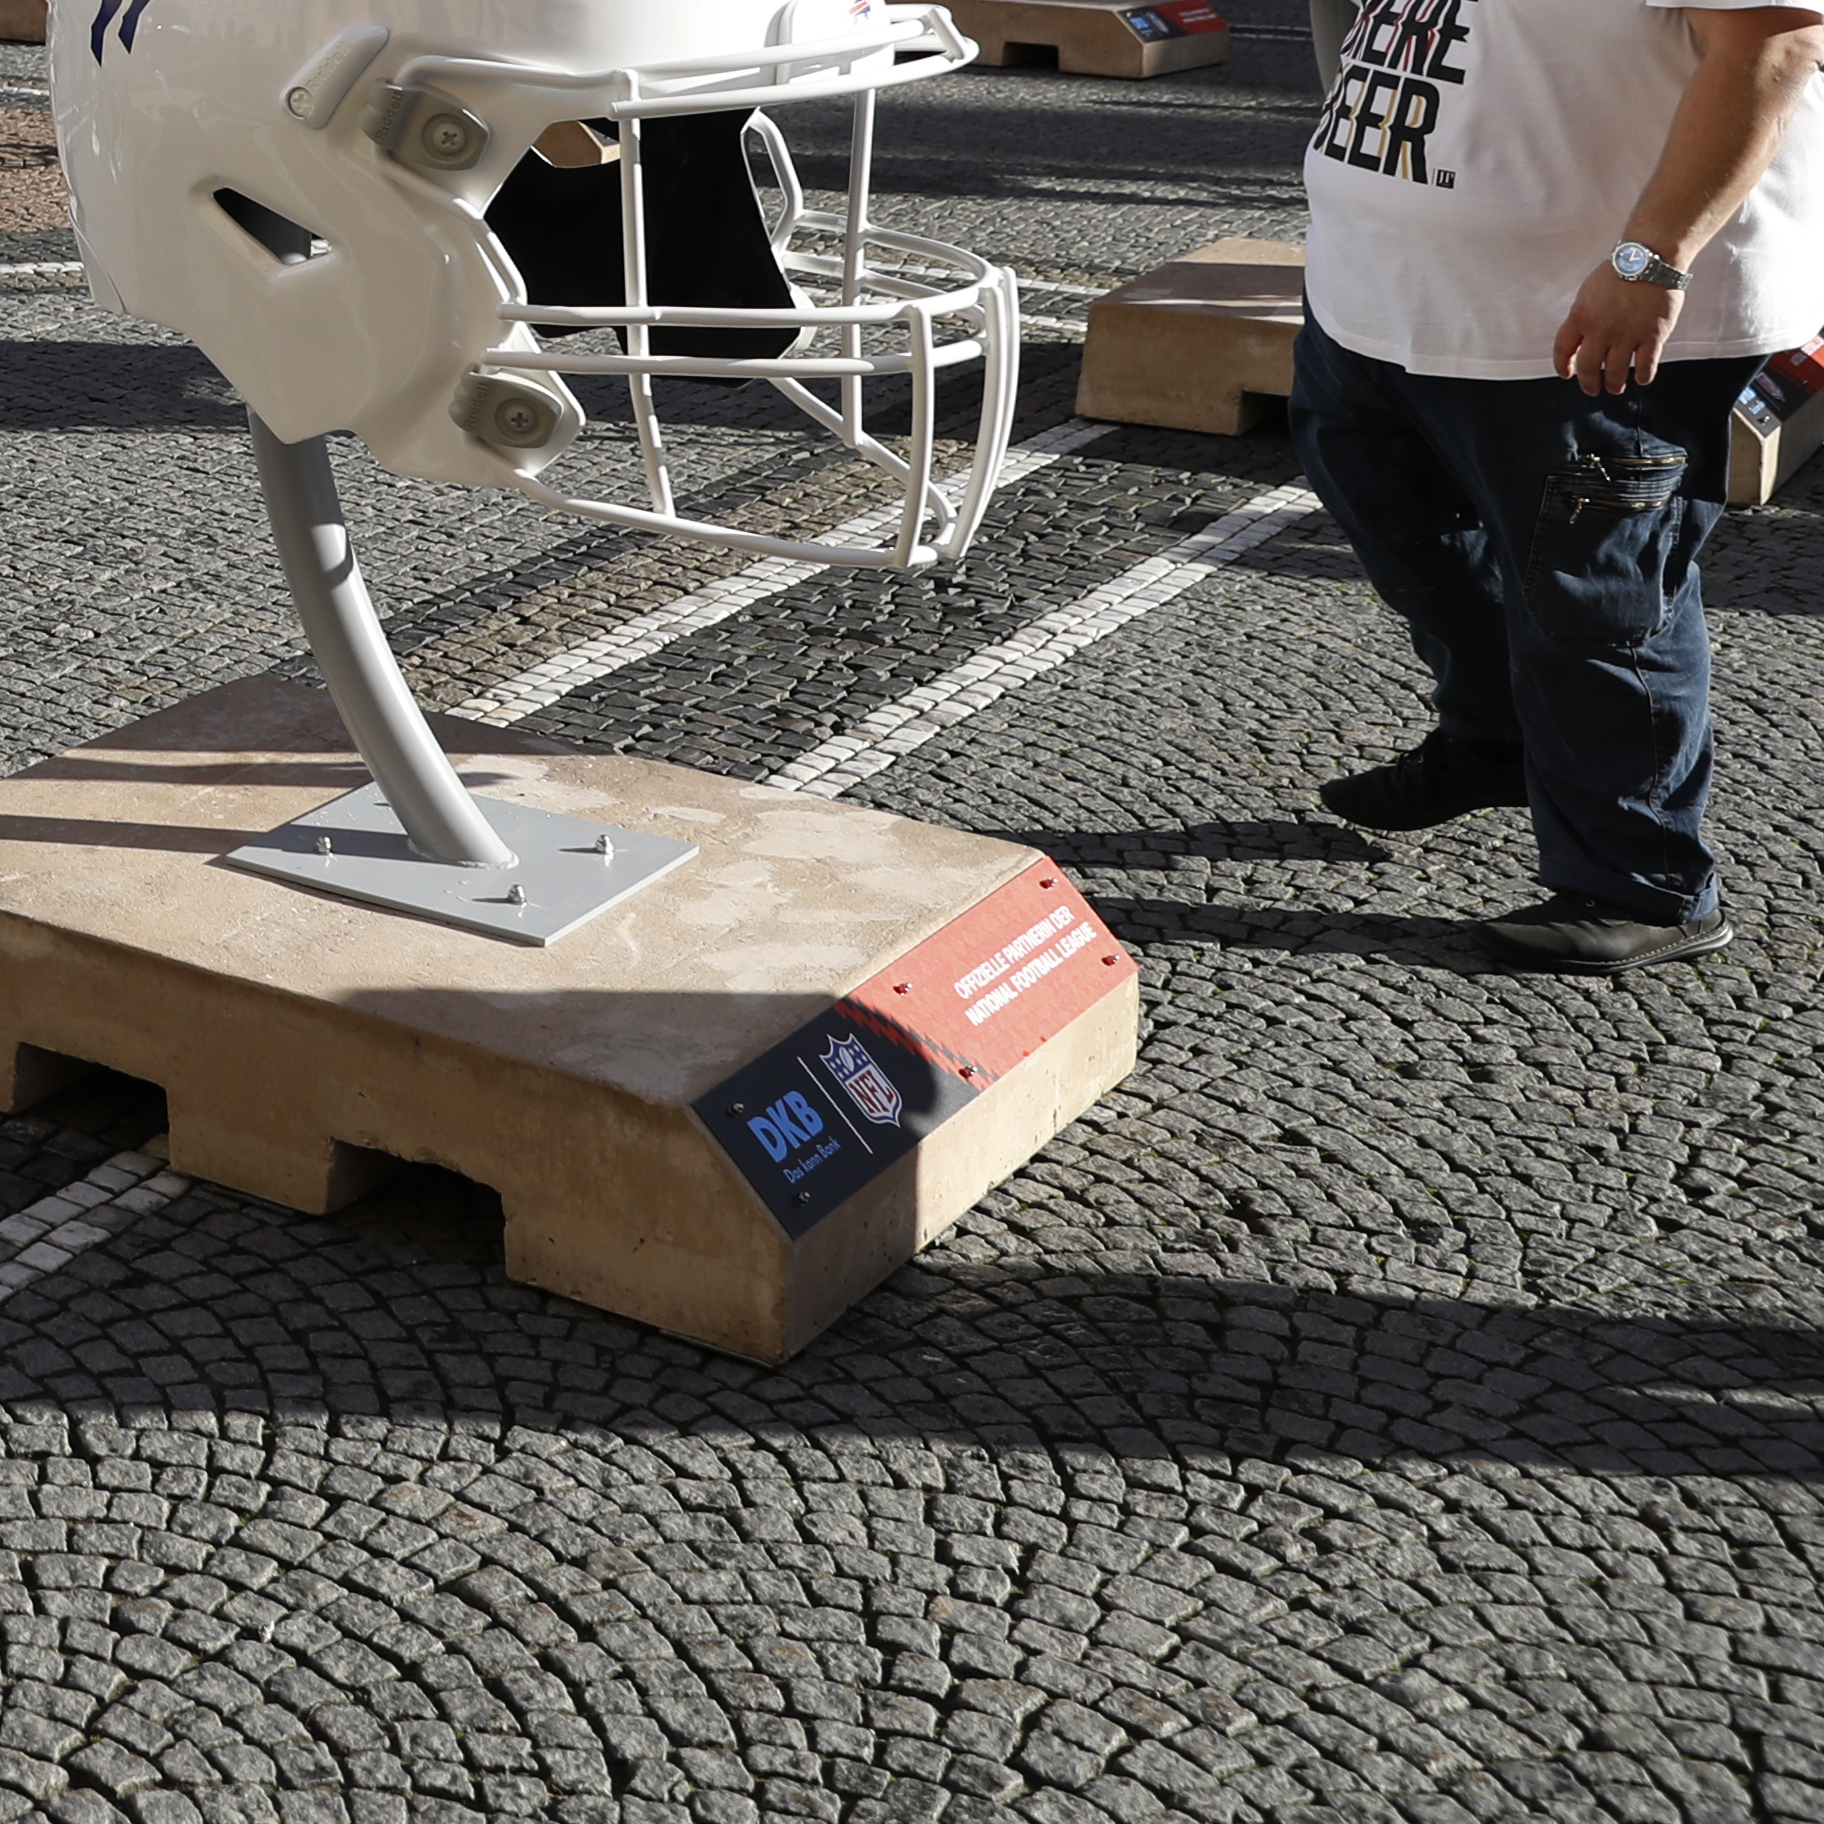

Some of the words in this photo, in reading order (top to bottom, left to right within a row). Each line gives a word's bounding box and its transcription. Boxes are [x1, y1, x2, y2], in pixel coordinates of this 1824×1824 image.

[375, 90, 404, 142] Riddell
[954, 951, 1011, 1000] OFFIZIELLE
[1002, 917, 1058, 965] PARTNERIN
[1049, 905, 1076, 930] DER
[964, 982, 1019, 1027] NATIONAL
[1009, 947, 1064, 993] FOOTBALL
[1054, 921, 1098, 958] LEAGUE
[847, 1070, 895, 1114] NFL
[747, 1090, 824, 1163] DKB
[783, 1164, 805, 1184] Das
[798, 1150, 823, 1172] kann
[816, 1135, 841, 1159] Bank
